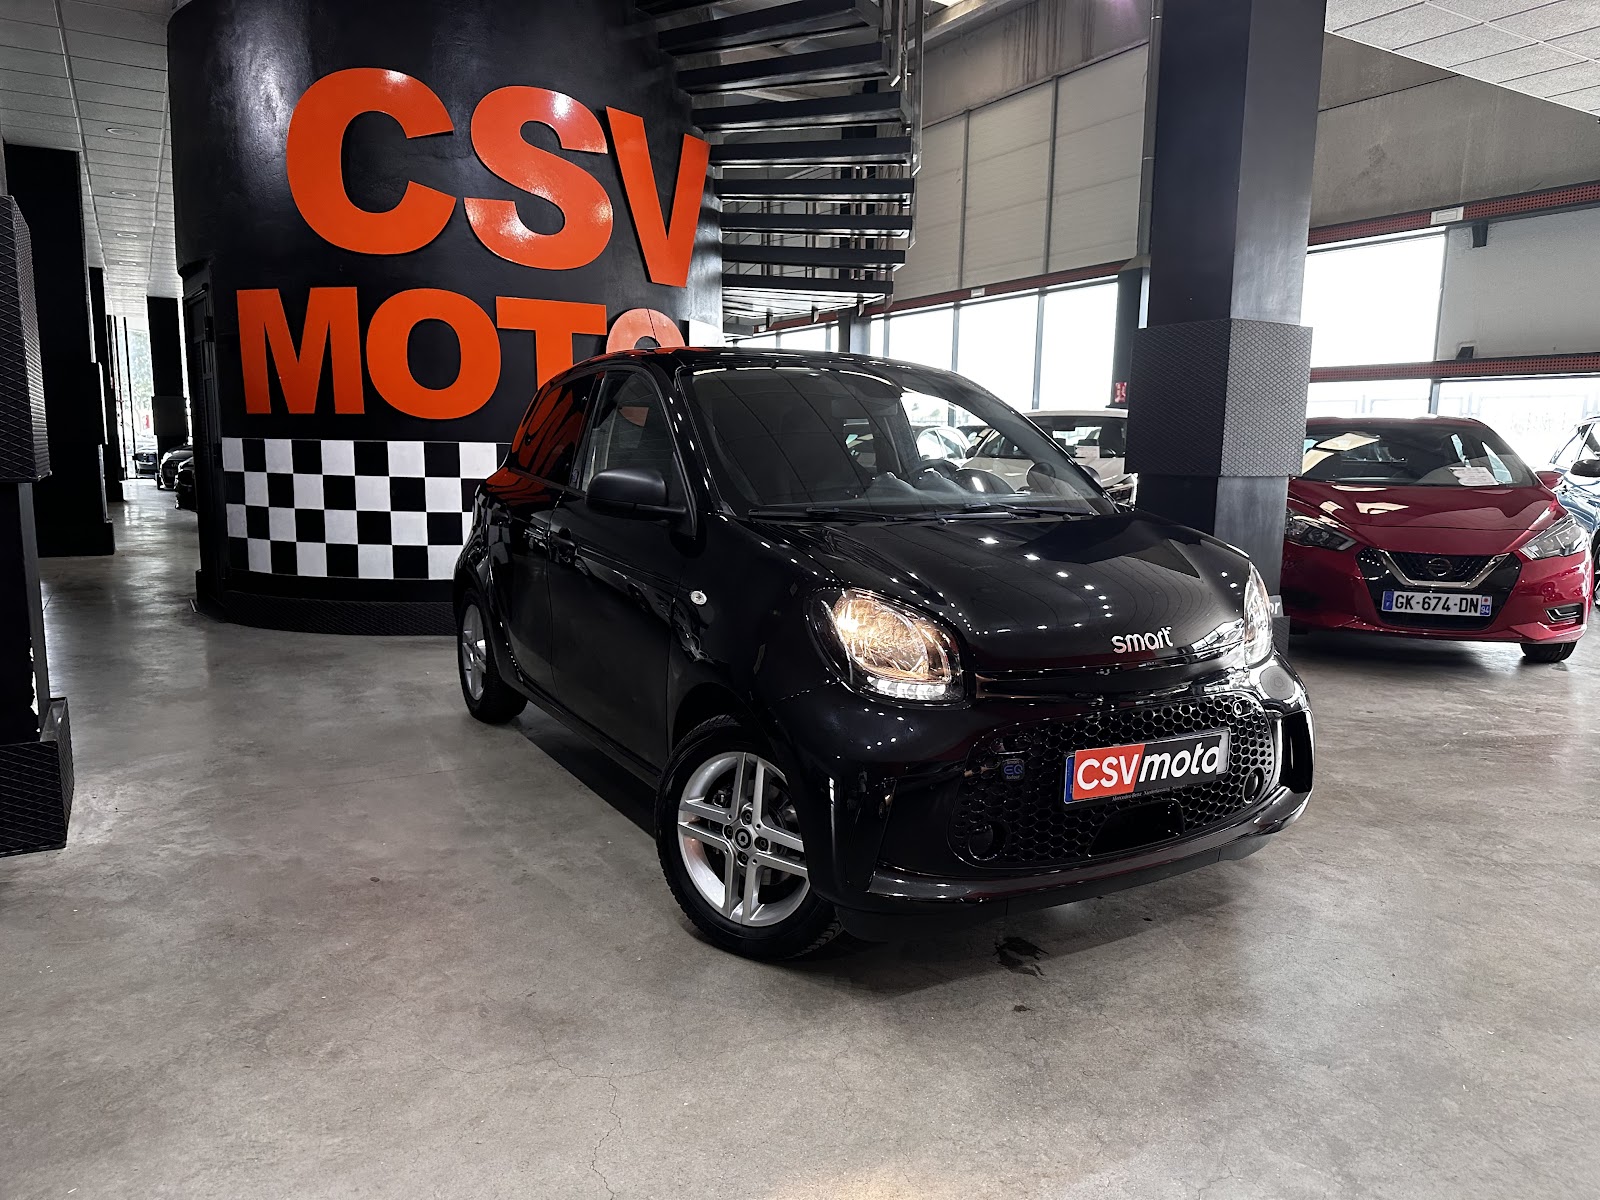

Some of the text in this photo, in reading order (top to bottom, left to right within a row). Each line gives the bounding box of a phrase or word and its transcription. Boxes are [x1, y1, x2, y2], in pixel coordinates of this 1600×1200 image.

[286, 67, 711, 288] CSV
[1395, 595, 1479, 613] GK-674-DN
[1480, 605, 1490, 614] 94
[1111, 626, 1173, 653] smart
[1004, 764, 1023, 775] EQ
